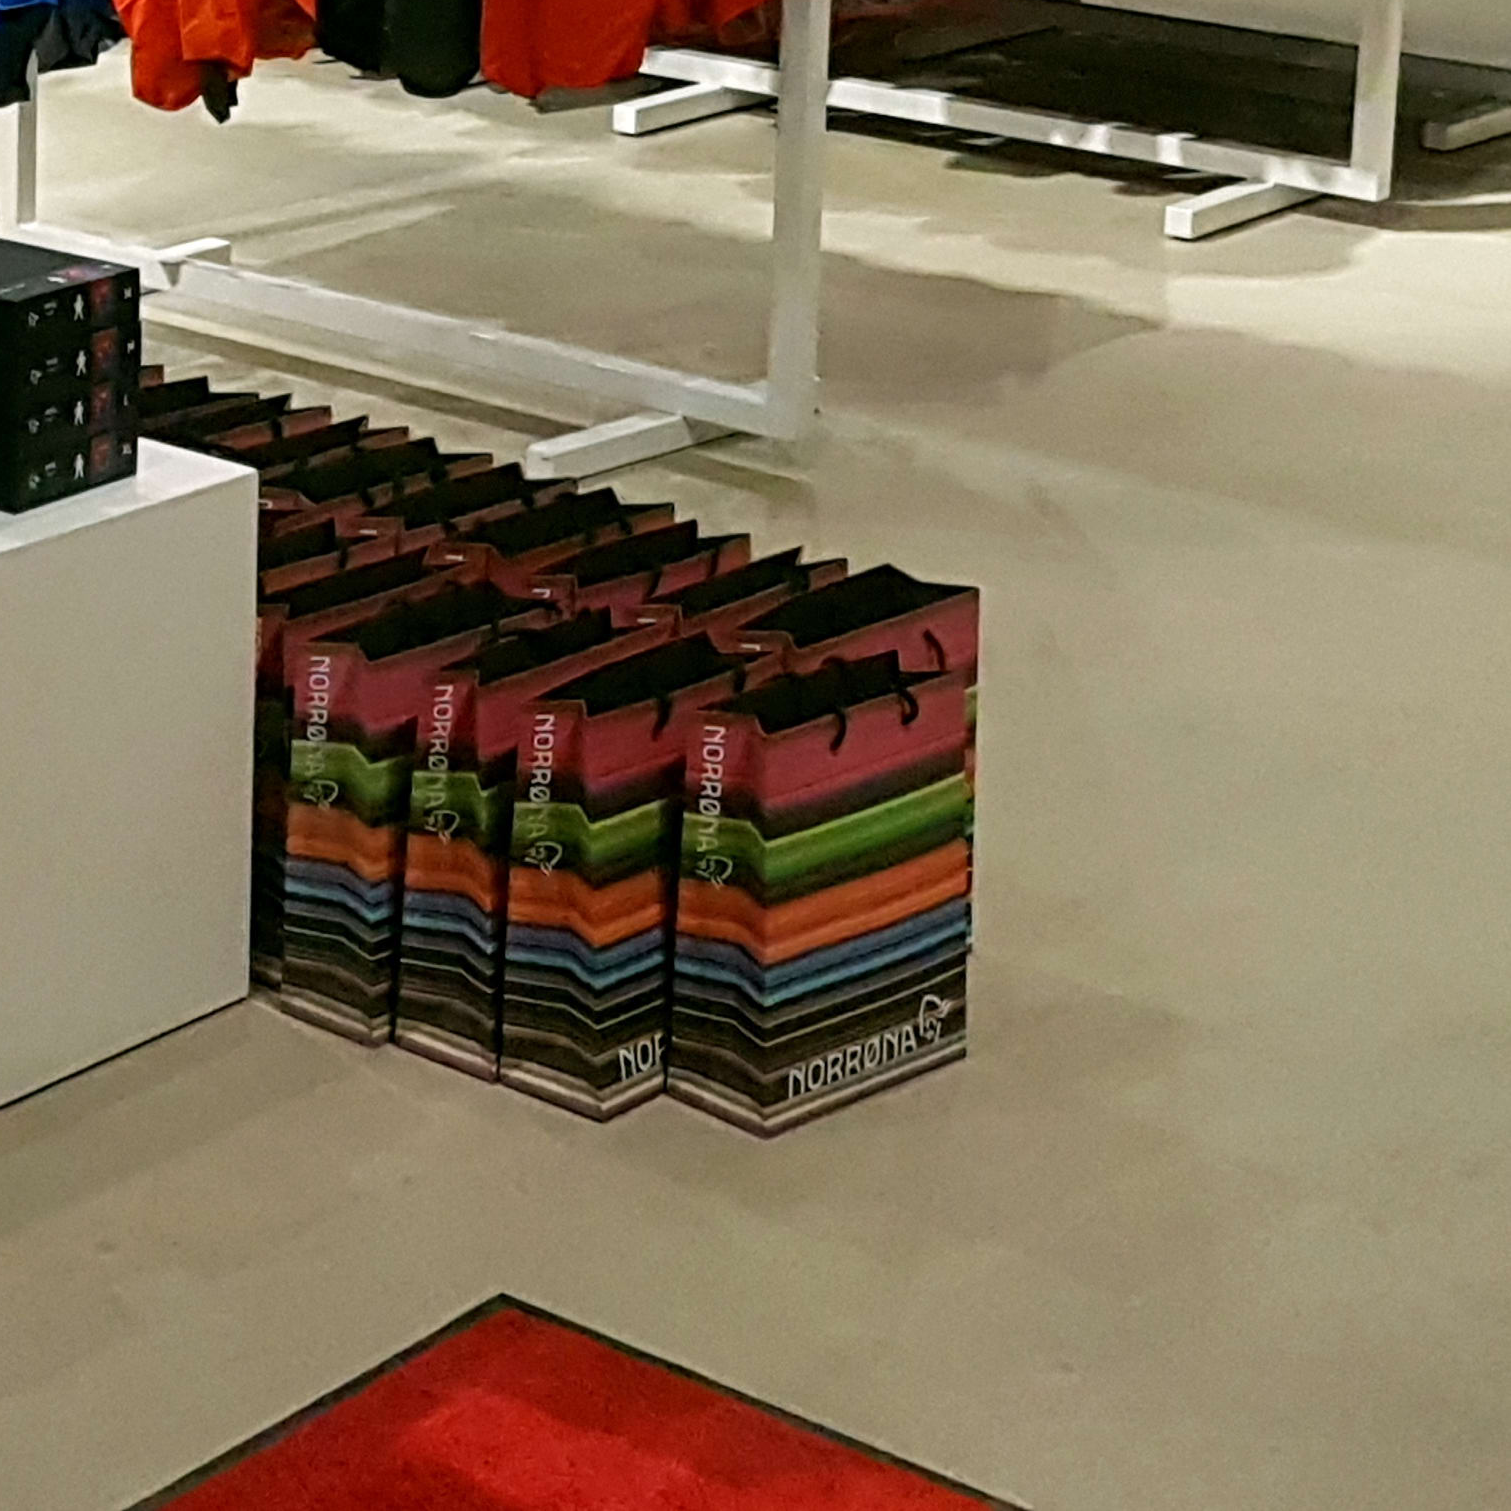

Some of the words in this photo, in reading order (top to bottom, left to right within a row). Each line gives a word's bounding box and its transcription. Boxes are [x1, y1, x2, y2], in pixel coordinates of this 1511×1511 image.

[425, 683, 454, 810] NORRØNA
[696, 724, 728, 854] NORRØNA
[788, 1024, 919, 1100] NORRØNA
